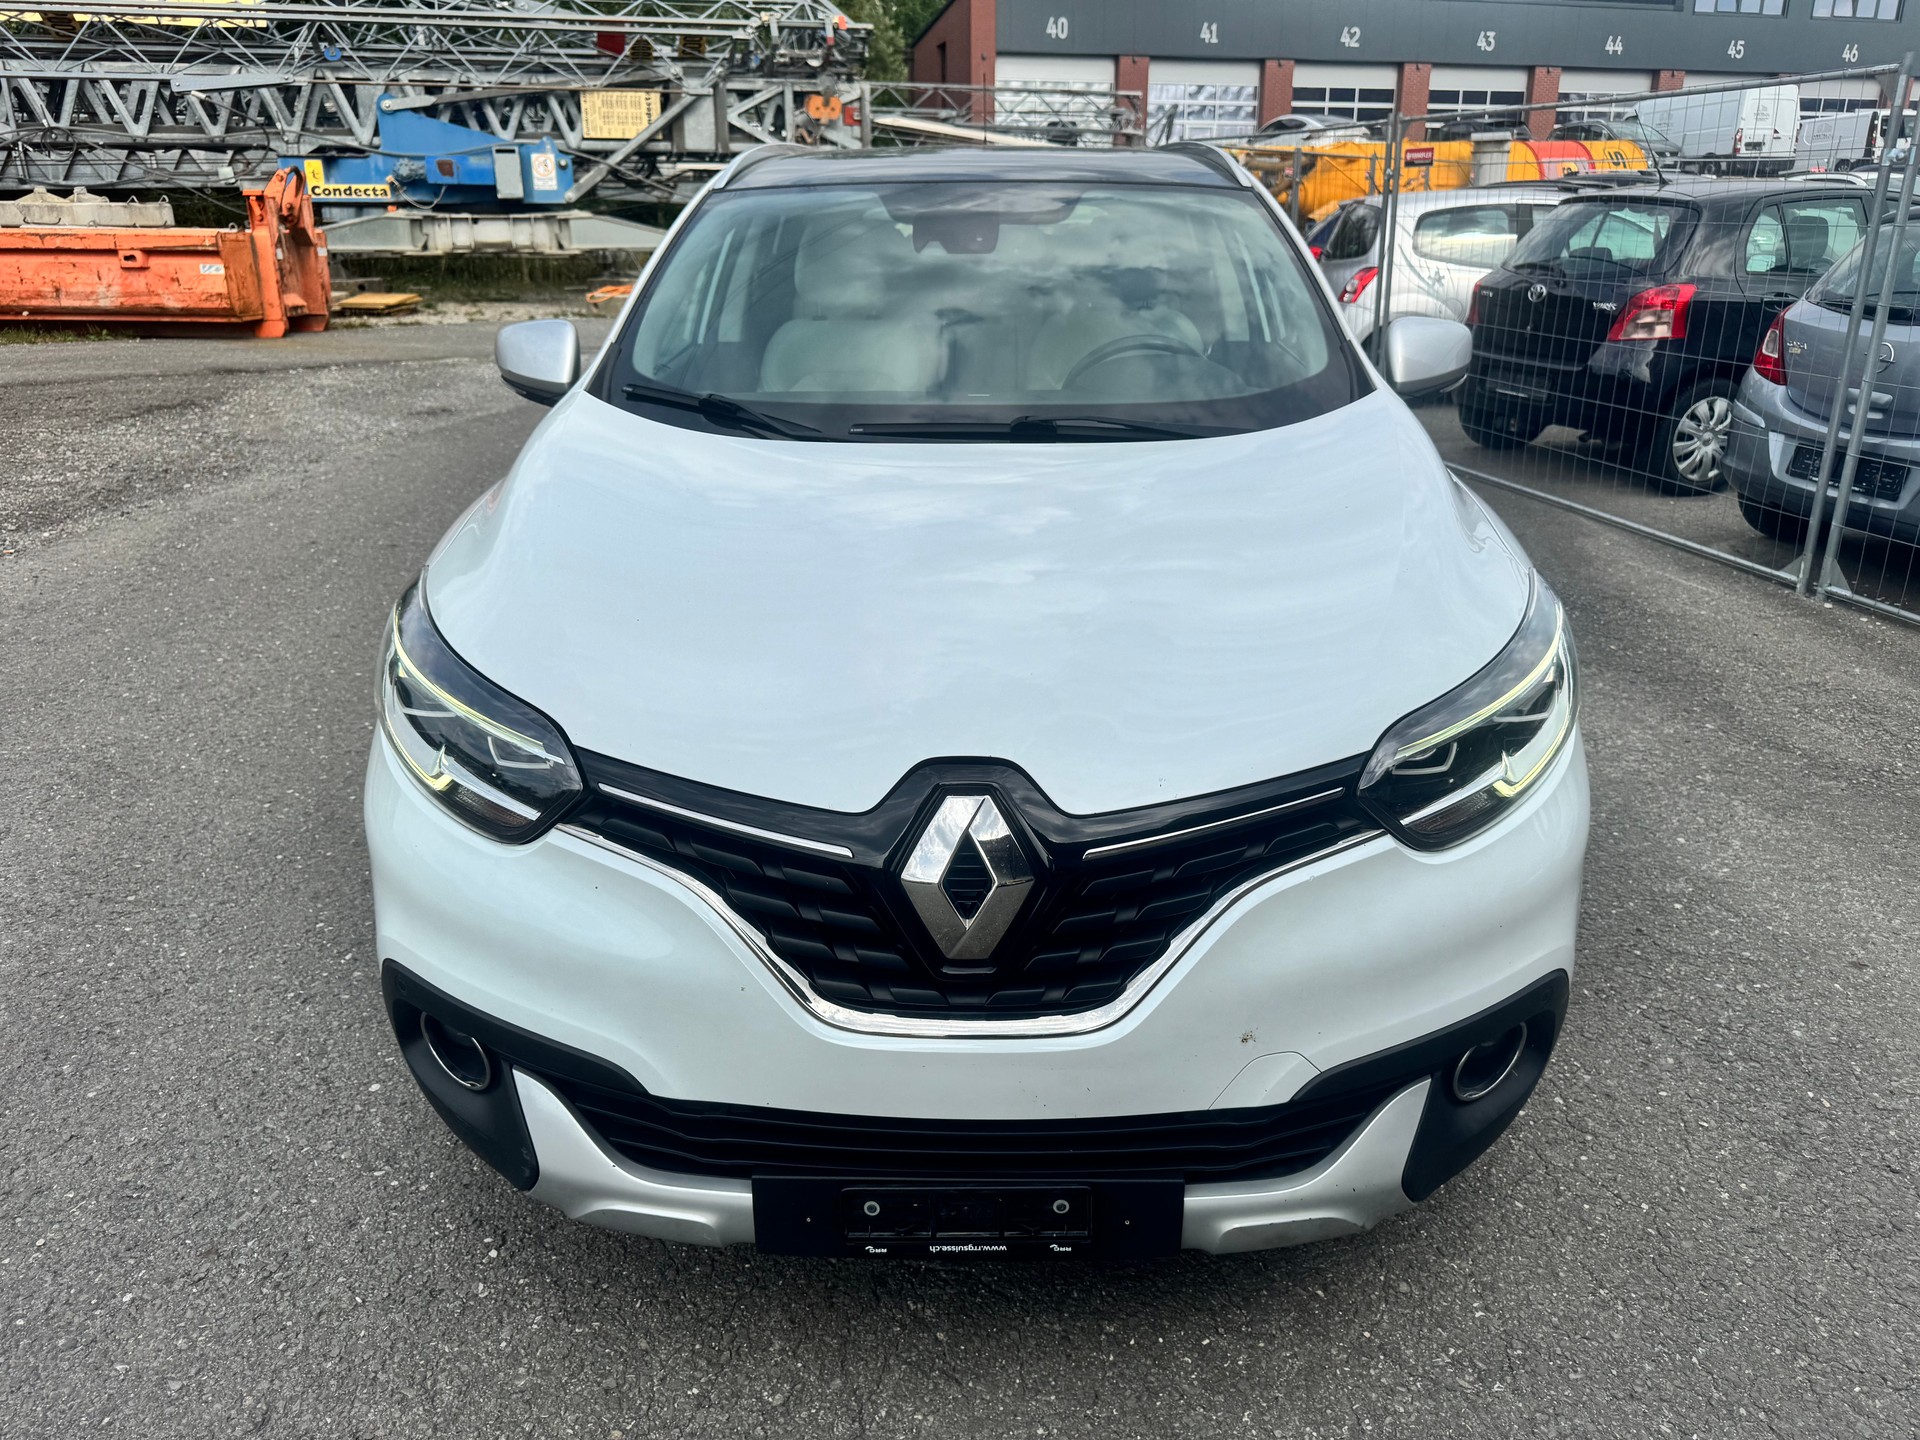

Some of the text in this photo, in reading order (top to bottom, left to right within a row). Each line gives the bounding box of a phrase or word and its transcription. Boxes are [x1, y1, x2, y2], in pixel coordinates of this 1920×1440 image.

[1045, 16, 1069, 40] 40
[1199, 21, 1219, 44] 41
[1340, 26, 1361, 48] 42
[1476, 30, 1497, 52] 43
[1604, 35, 1623, 55] 44
[1727, 39, 1745, 59] 45
[1841, 43, 1859, 63] 46
[311, 185, 388, 197] Condecta
[929, 1243, 1008, 1253] www.rrgsuisse.ch
